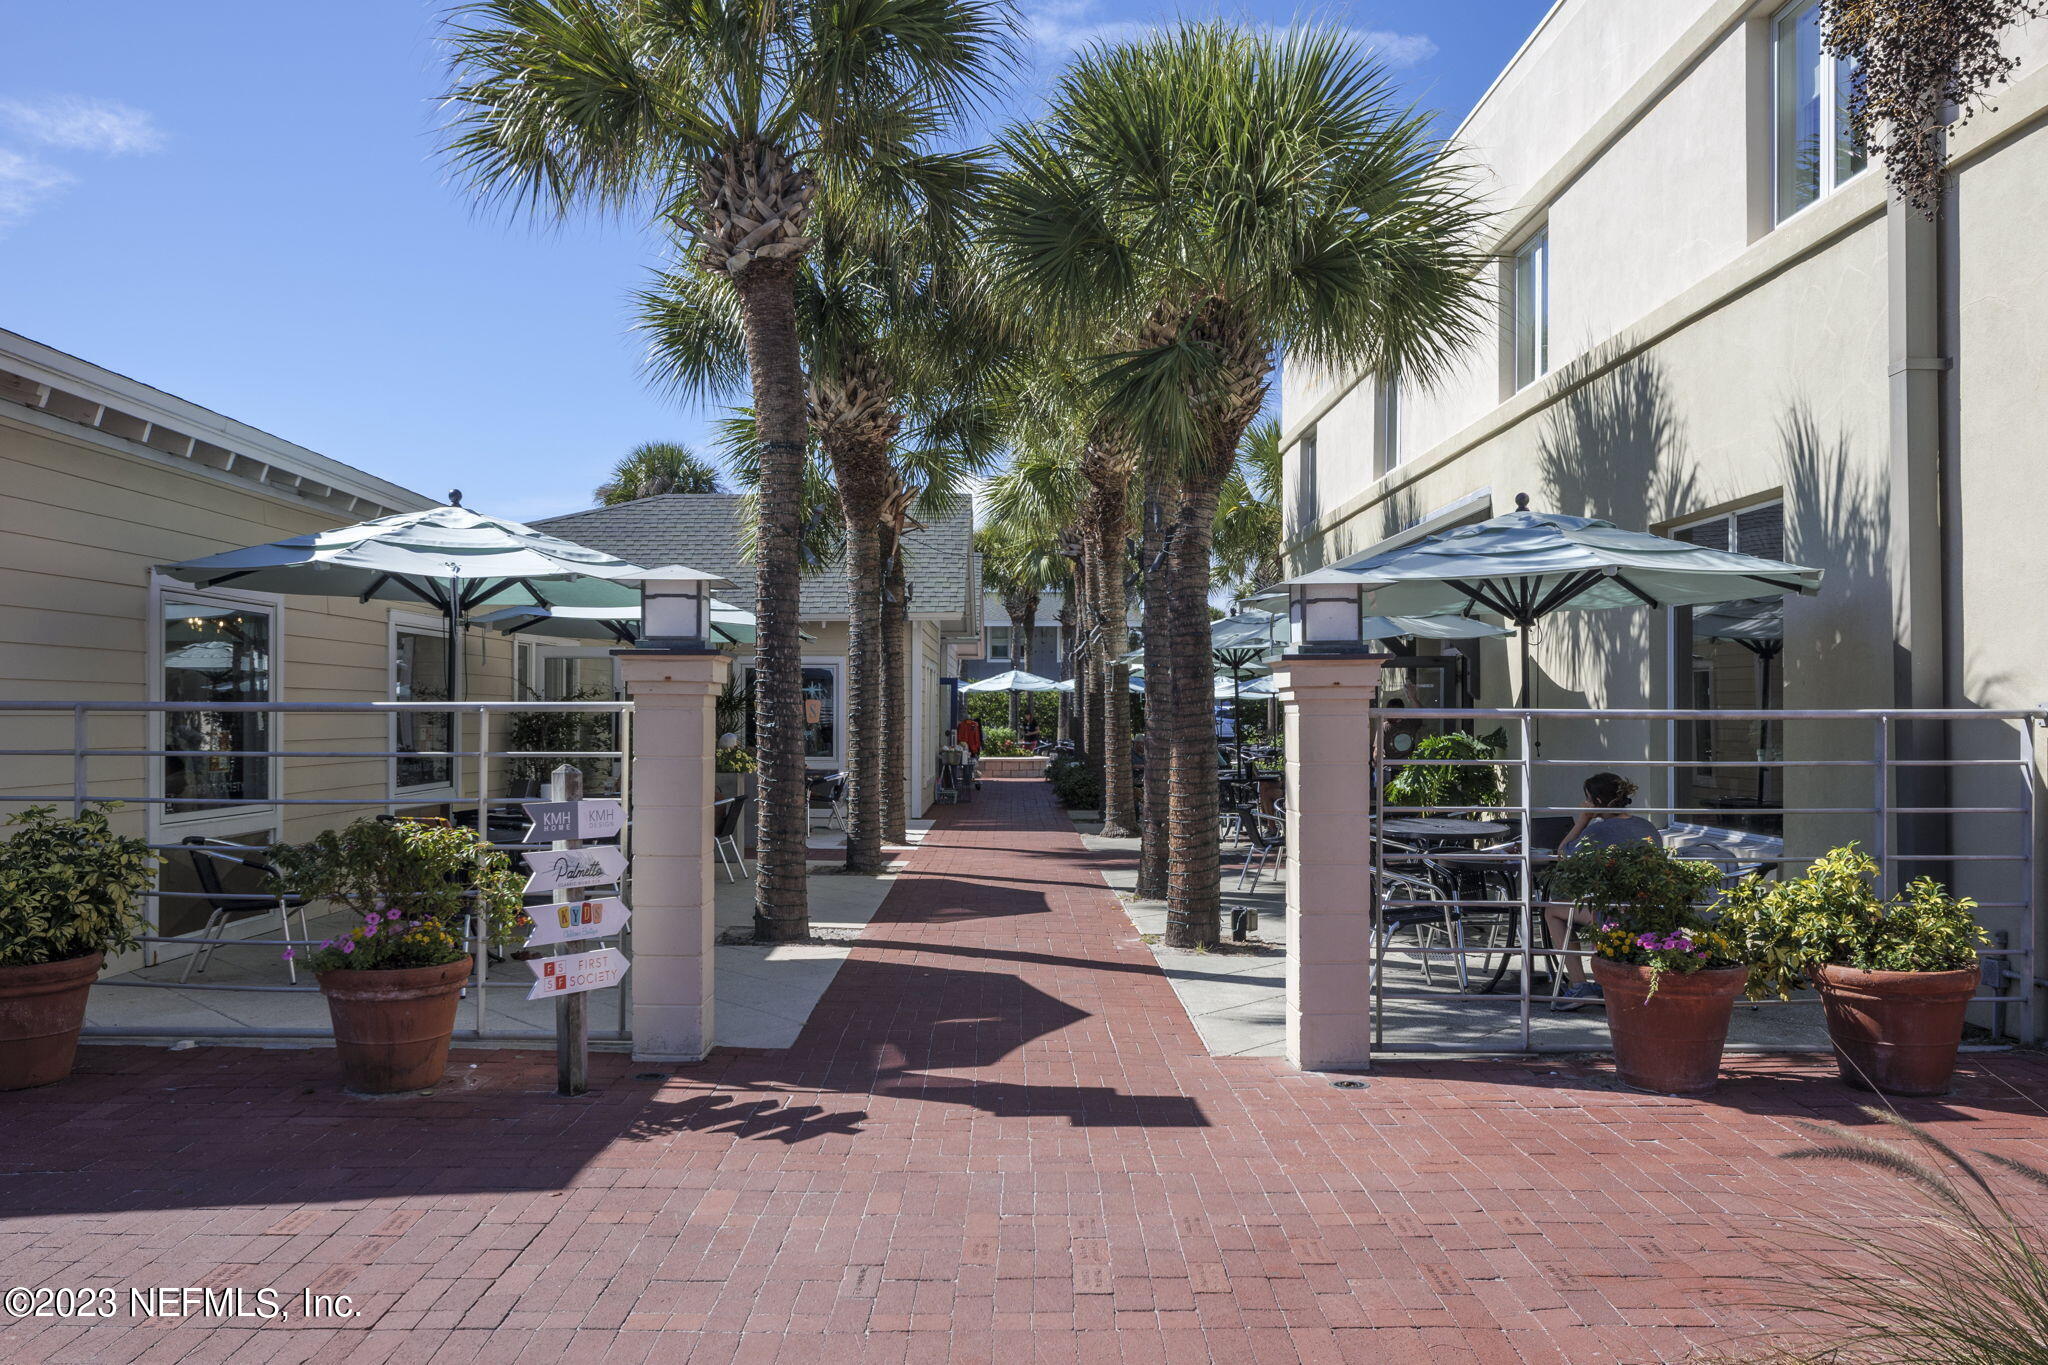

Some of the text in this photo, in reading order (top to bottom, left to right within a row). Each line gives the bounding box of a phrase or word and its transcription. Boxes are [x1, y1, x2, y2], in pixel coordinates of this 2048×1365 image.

[543, 811, 571, 826] KMH
[588, 809, 614, 822] KMH
[543, 824, 571, 832] HOME
[553, 857, 602, 882] Palmetto
[559, 904, 602, 925] KYDS
[578, 956, 609, 970] FIRST
[569, 968, 618, 987] SOCIETY
